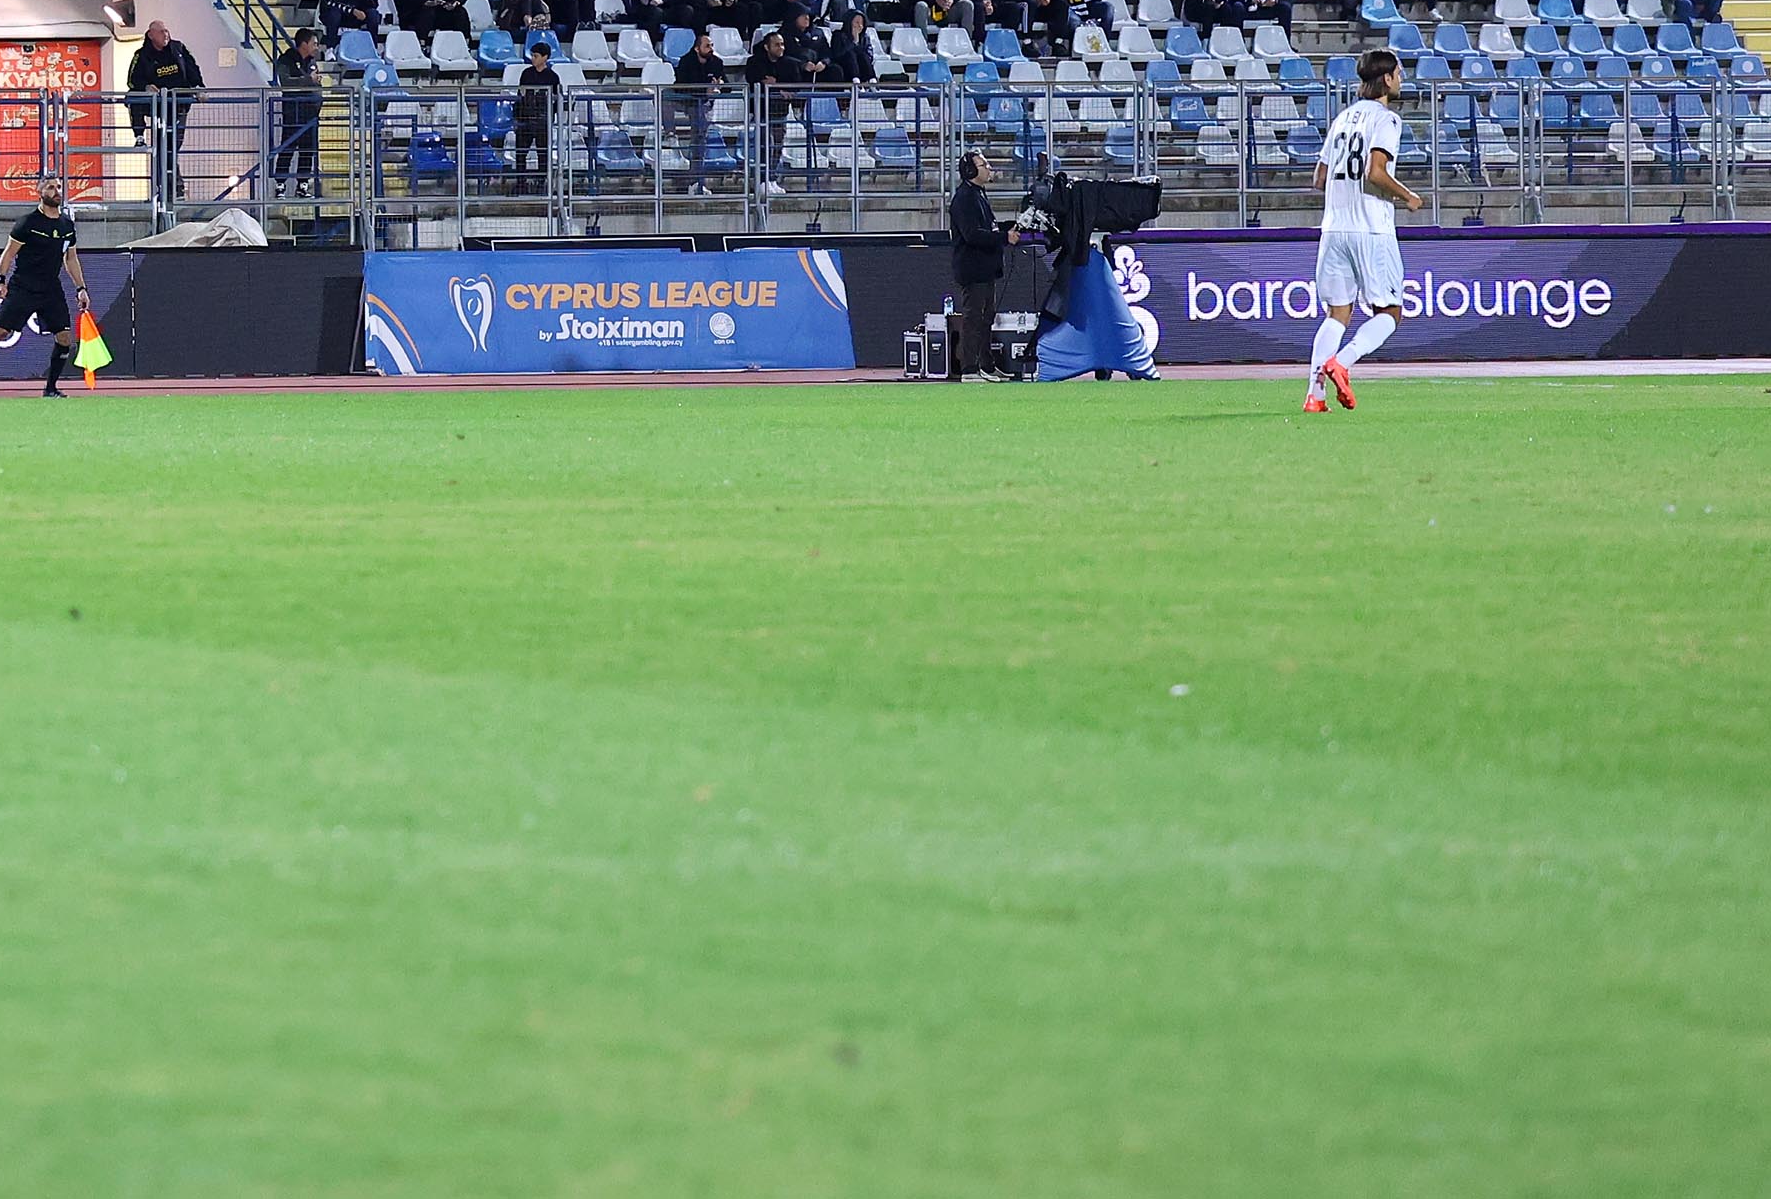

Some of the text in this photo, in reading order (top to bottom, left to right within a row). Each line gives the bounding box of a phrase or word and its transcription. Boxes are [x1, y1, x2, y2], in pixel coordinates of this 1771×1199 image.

[1331, 131, 1364, 181] 28
[506, 281, 777, 309] CYPRUS LEAGUE
[1188, 271, 1612, 329] baraslounge
[538, 313, 684, 342] by Stoiximan
